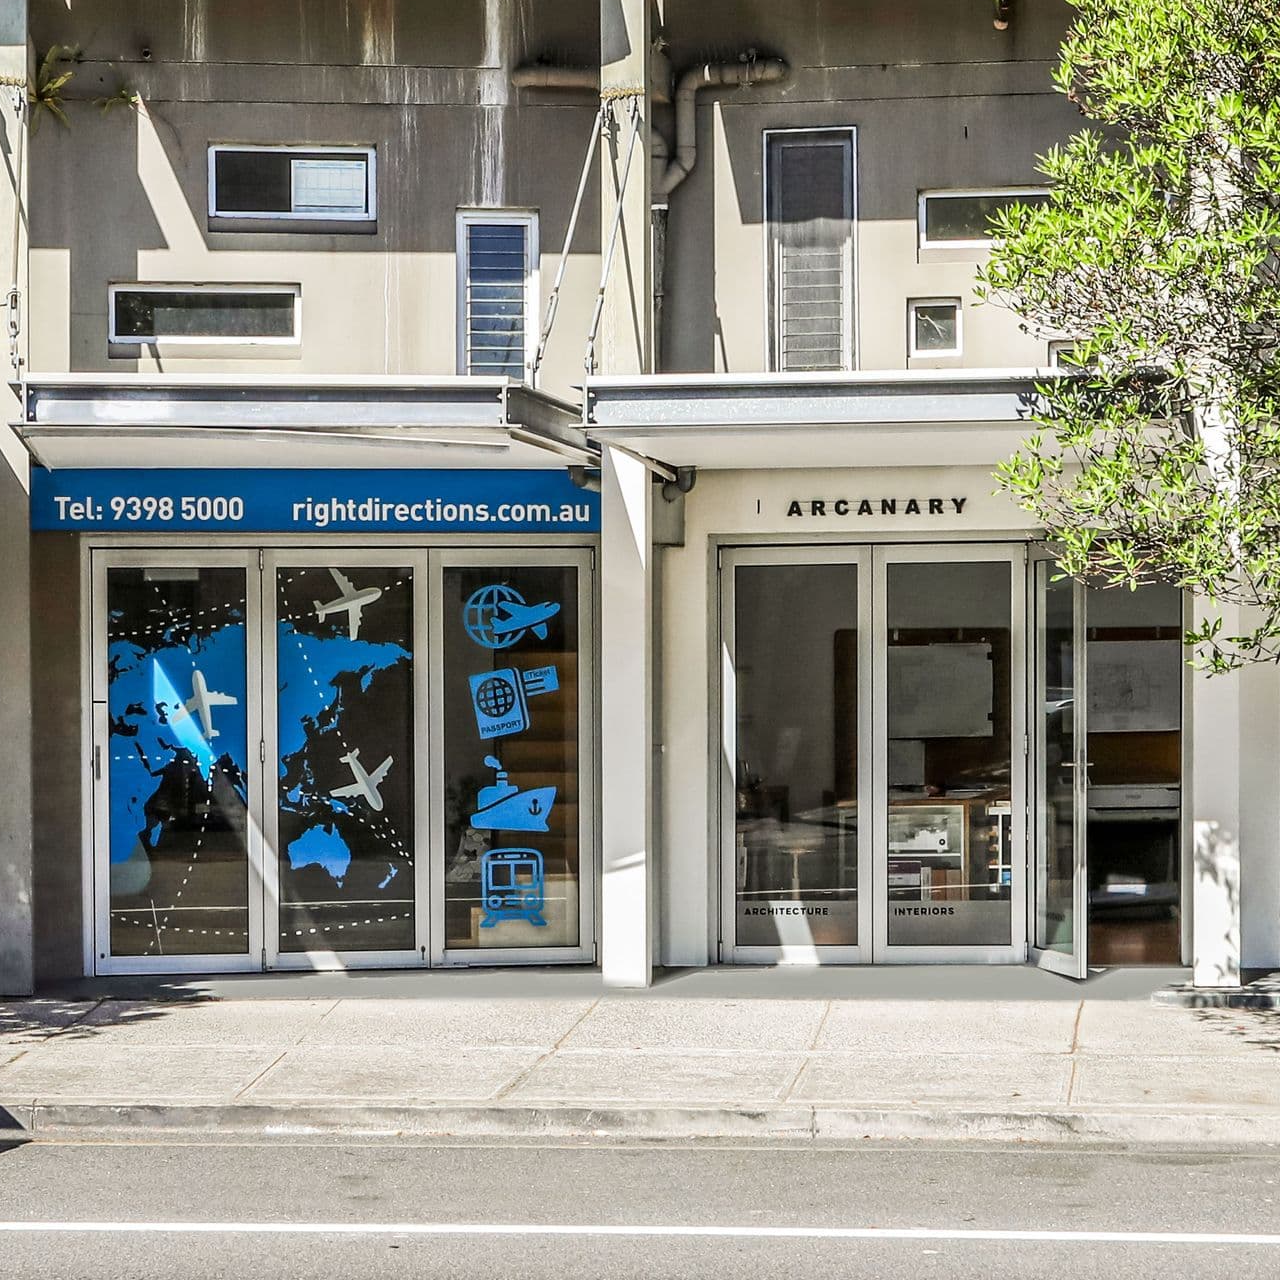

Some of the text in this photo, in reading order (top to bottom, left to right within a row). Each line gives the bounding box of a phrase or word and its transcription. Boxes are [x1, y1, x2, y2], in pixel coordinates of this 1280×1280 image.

[54, 496, 244, 521] Tel: 9398 5000
[292, 497, 591, 527] rightdirections.com.au
[786, 497, 968, 517] ARCANARY
[481, 720, 521, 734] PASSPORT
[744, 907, 829, 916] ARCHITECTURE
[894, 907, 955, 916] INTERIORS
